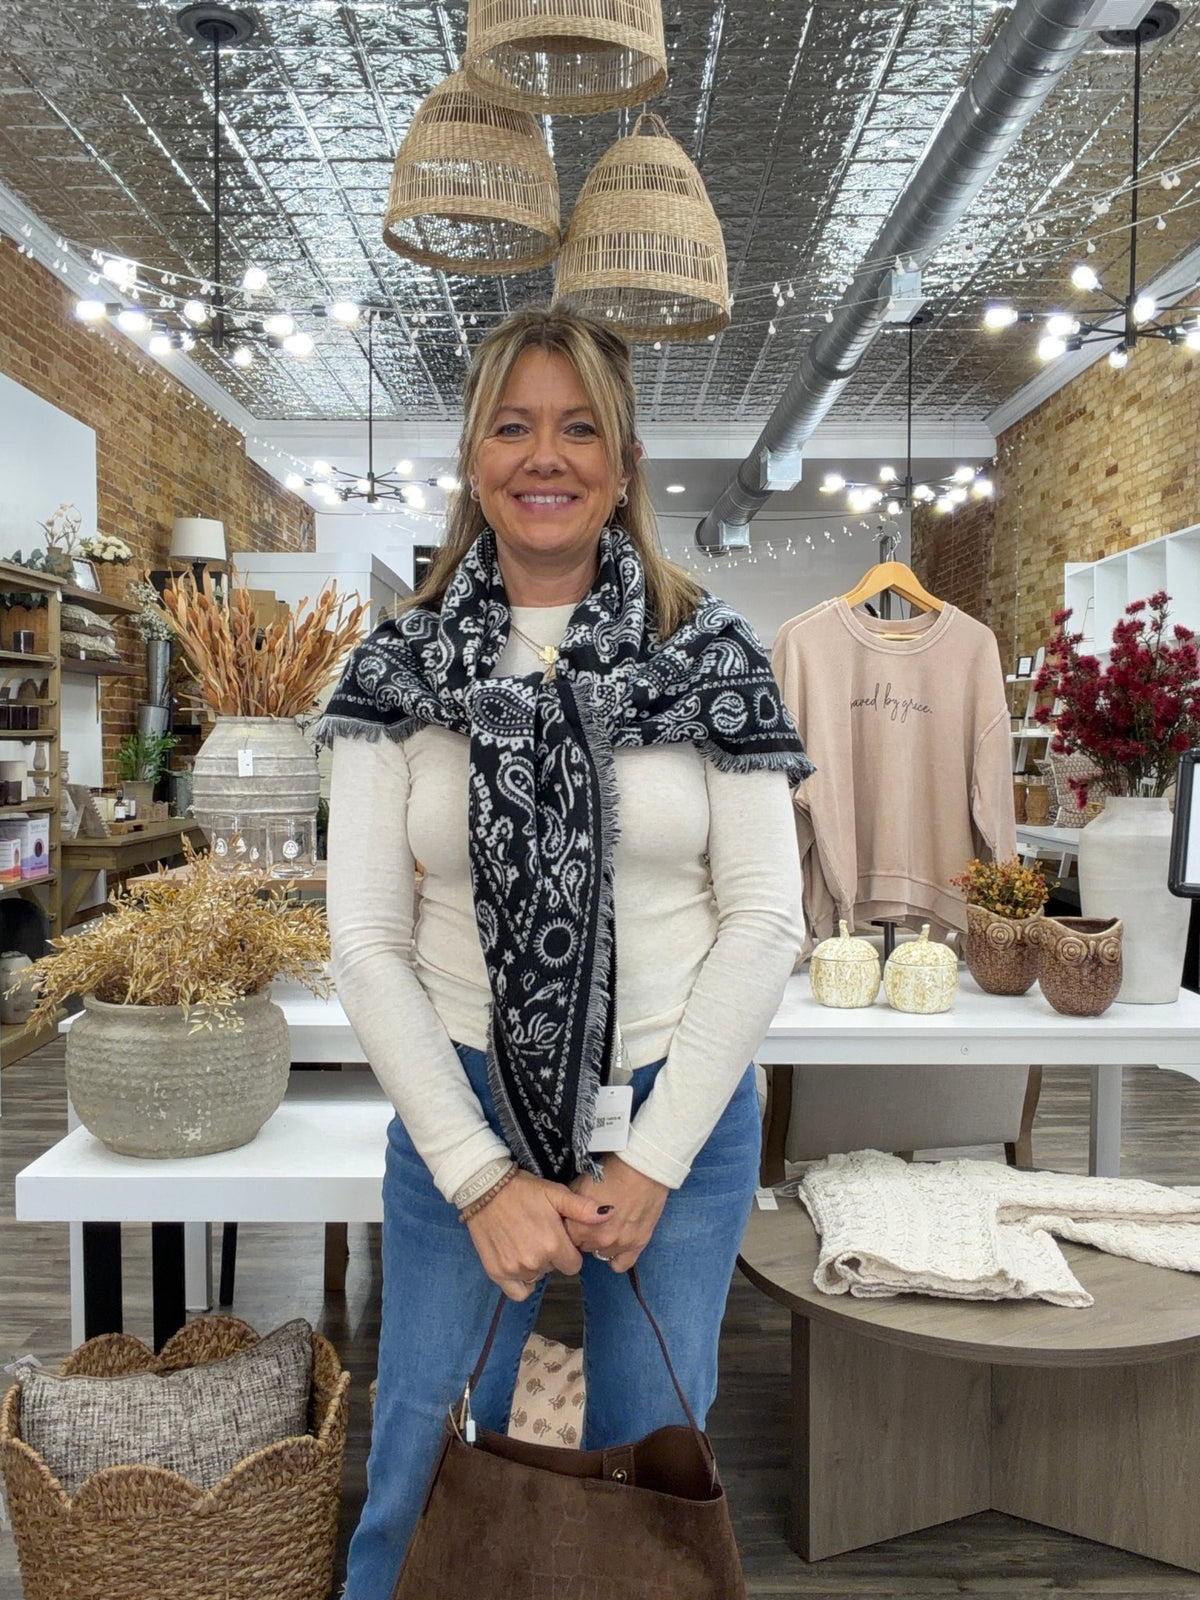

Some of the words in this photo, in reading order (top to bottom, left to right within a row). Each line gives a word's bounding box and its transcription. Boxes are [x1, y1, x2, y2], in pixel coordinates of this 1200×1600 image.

[850, 682, 880, 711] aved
[883, 682, 899, 721] by
[468, 1165, 501, 1196] ALWAYS
